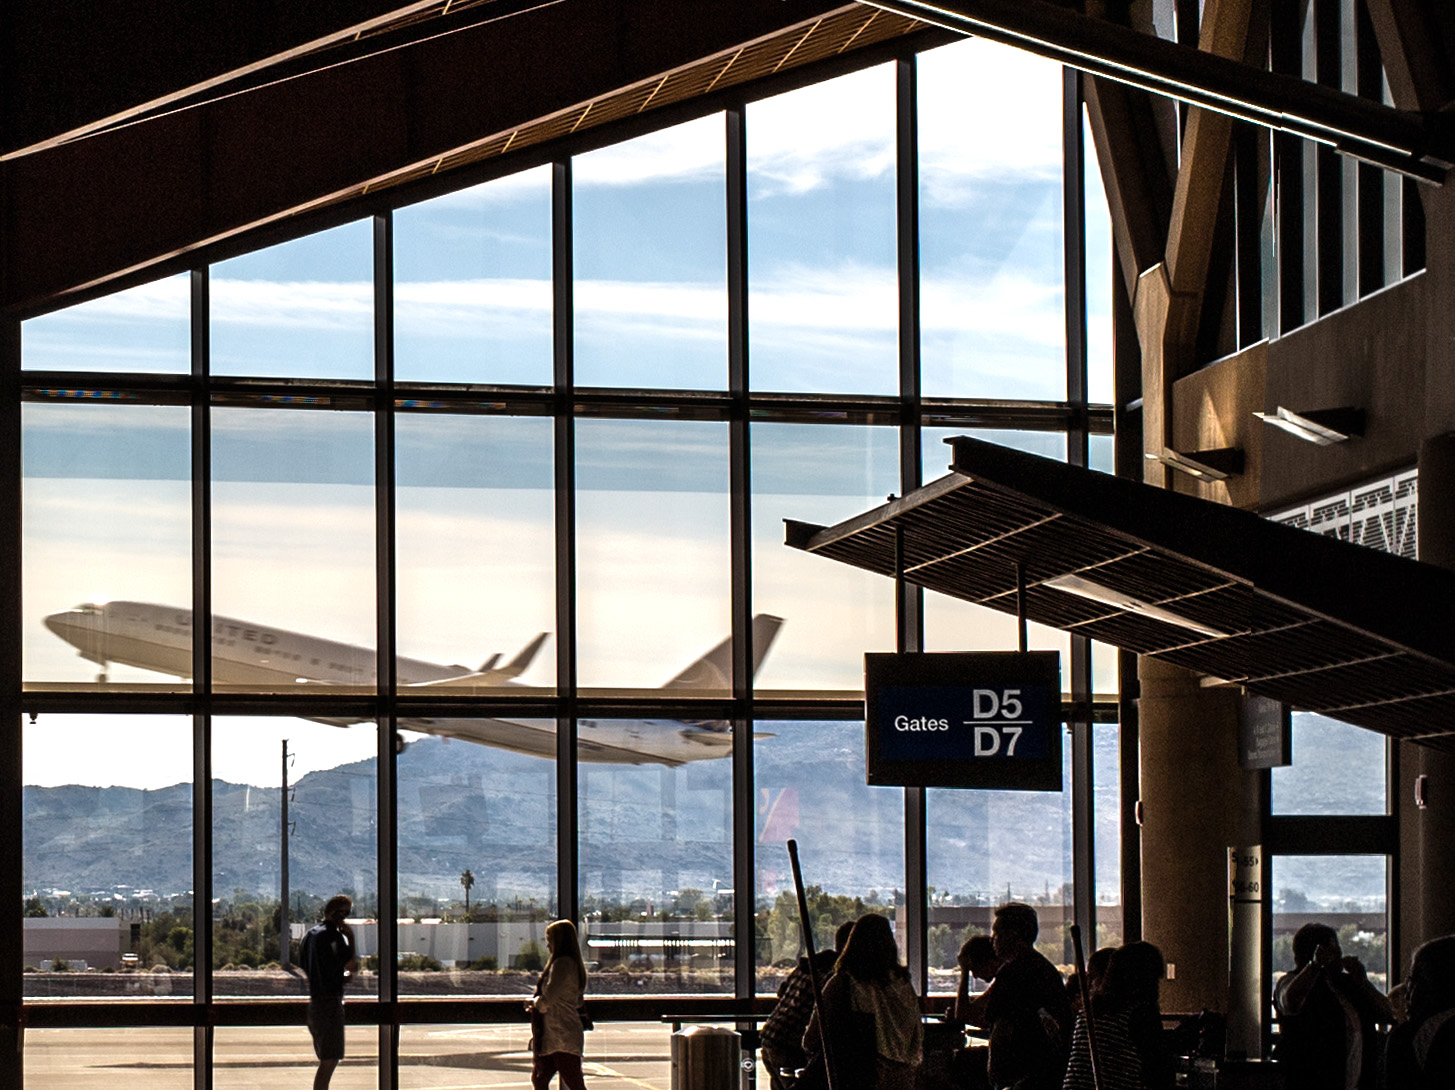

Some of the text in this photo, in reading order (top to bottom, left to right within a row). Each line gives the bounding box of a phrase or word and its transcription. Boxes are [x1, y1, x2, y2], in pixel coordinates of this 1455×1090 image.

[176, 614, 278, 645] UITED
[973, 690, 1022, 718] D5
[895, 715, 948, 731] Gates
[974, 727, 1022, 756] D7
